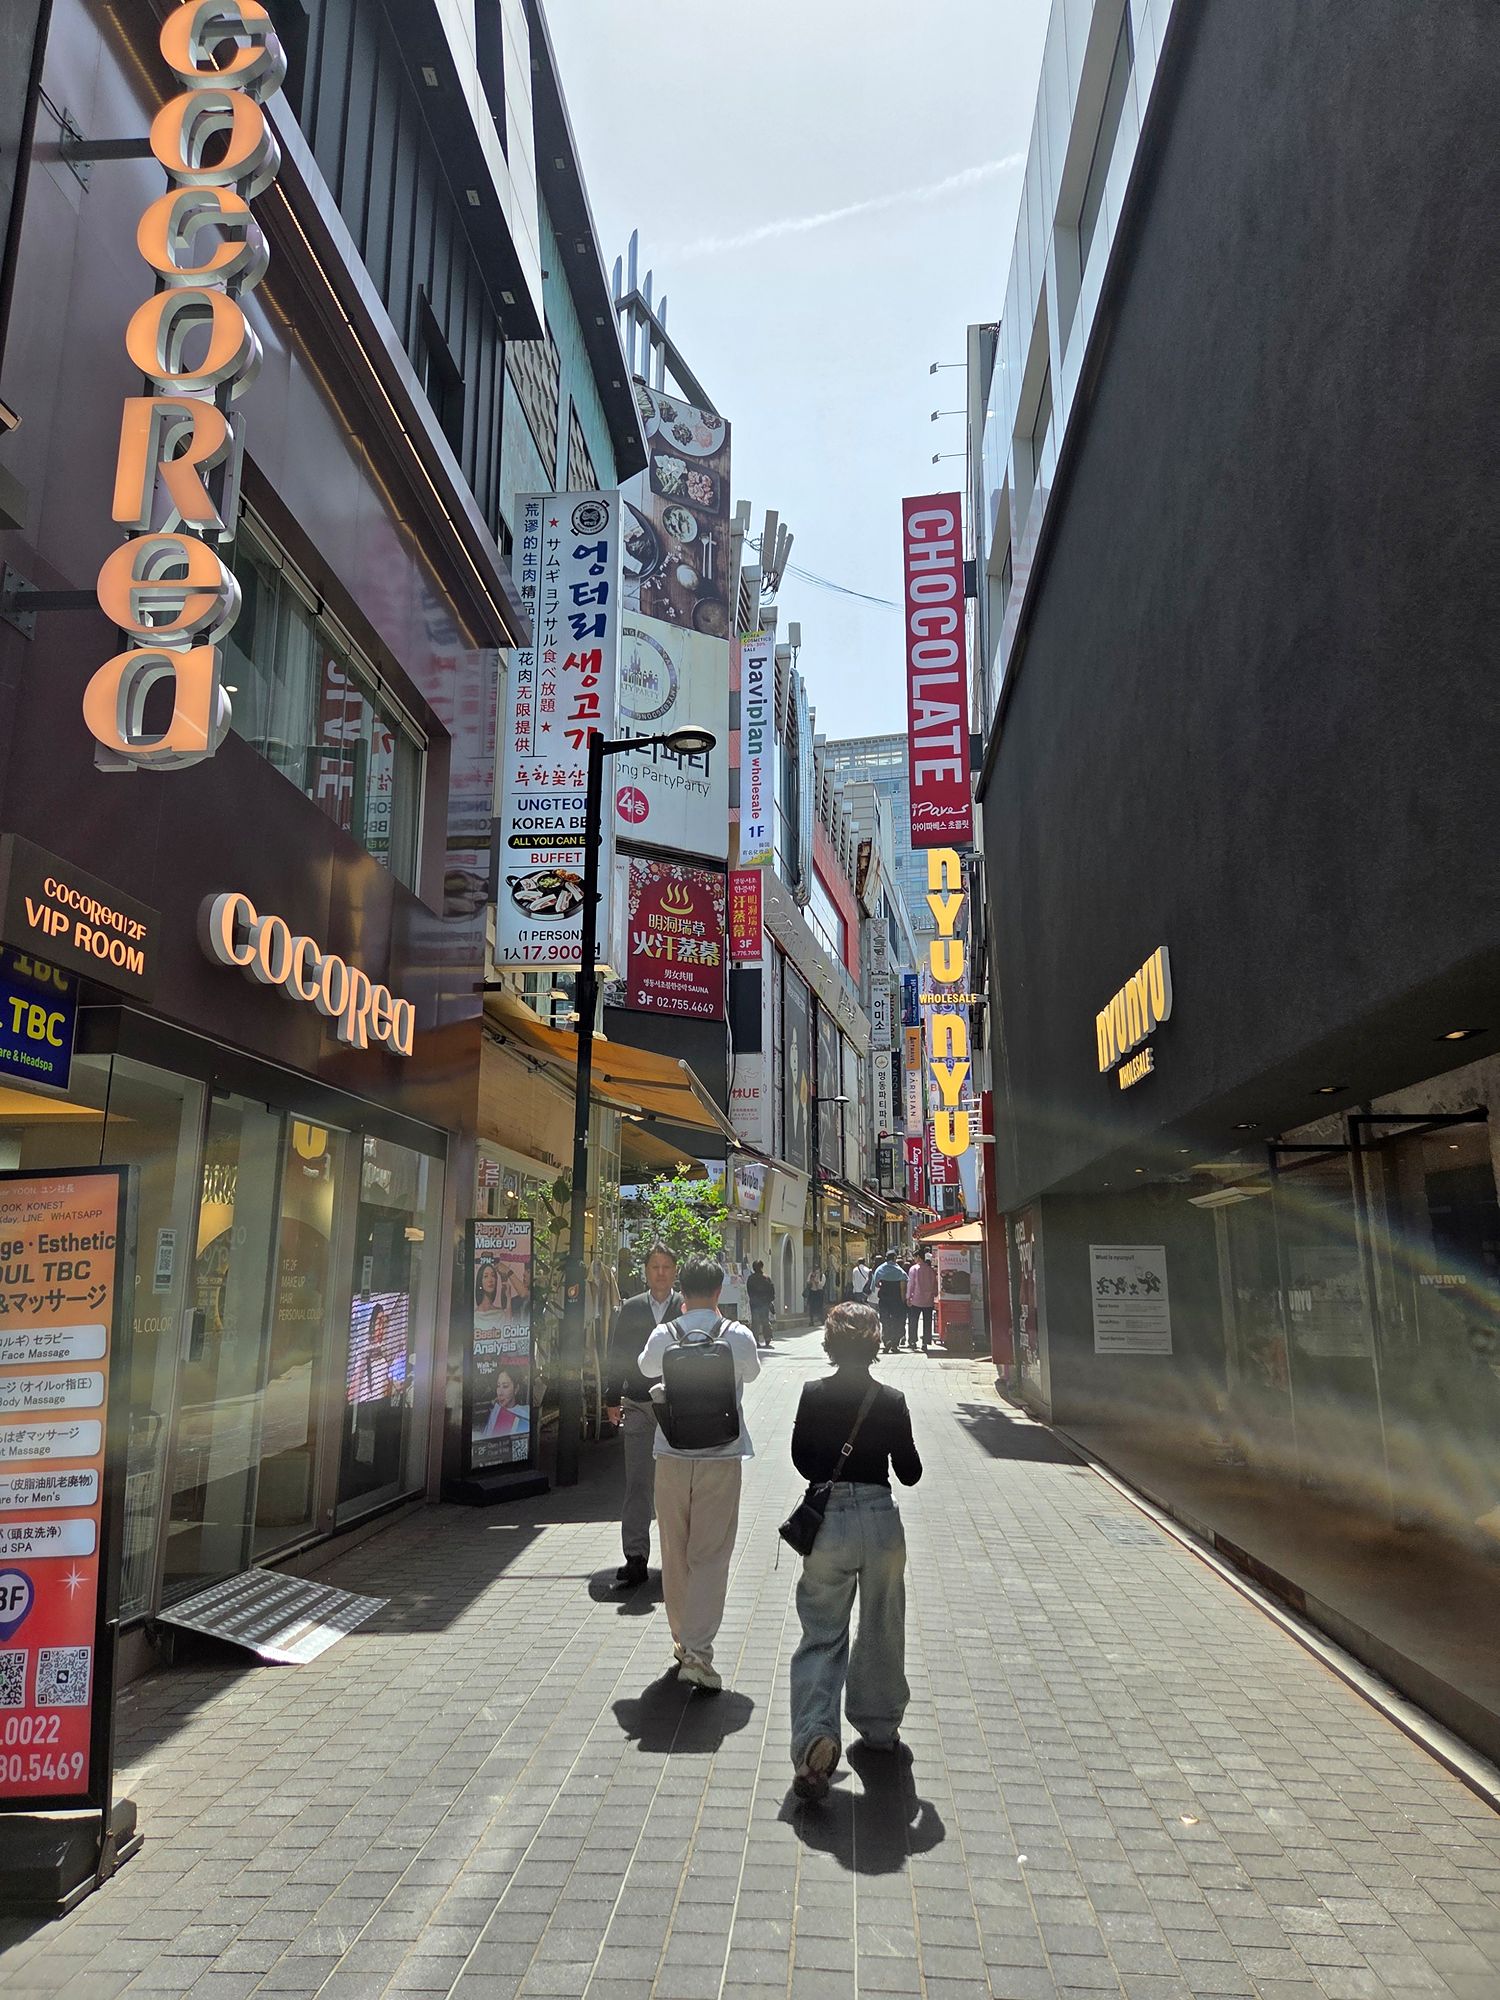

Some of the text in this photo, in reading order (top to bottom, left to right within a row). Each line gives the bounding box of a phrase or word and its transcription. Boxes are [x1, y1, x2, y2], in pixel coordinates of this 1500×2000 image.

[908, 509, 962, 786] CHOCOLATE
[751, 757, 760, 819] wholesale
[512, 817, 565, 830] KOREA
[748, 825, 765, 838] 1F
[513, 838, 531, 846] ALL
[533, 837, 554, 846] YOU
[557, 836, 576, 845] CAN
[531, 852, 582, 864] BUFFET
[648, 913, 706, 936] 明洞瑞草
[25, 896, 70, 937] VIP
[74, 921, 145, 976] ROOM
[633, 931, 720, 967] 火汗蒸幕
[739, 940, 752, 949] 3F
[687, 984, 709, 995] SAUNA
[637, 991, 714, 1014] 3F 02.755.4649
[919, 993, 978, 1004] WHOLESALE
[9, 996, 66, 1047] TBC
[873, 1000, 886, 1030] 아미소
[20, 1052, 53, 1072] Headspa
[1119, 1047, 1154, 1090] WHOLESALE
[27, 1201, 65, 1211] KONEST
[51, 1209, 103, 1221] WHATSAPP
[475, 1223, 531, 1237] Happy Hour
[38, 1230, 116, 1254] Esthetic
[475, 1238, 516, 1251] Make up
[43, 1260, 91, 1282] TBC
[279, 1292, 294, 1305] HAIR
[474, 1325, 530, 1340] Basic Color
[1, 1348, 70, 1360] Face Massage
[473, 1341, 517, 1356] Analysis
[24, 1394, 66, 1406] Massage
[9, 1446, 51, 1457] Massage
[14, 1493, 29, 1504] for
[31, 1491, 61, 1503] Men's
[10, 1541, 33, 1553] SPA
